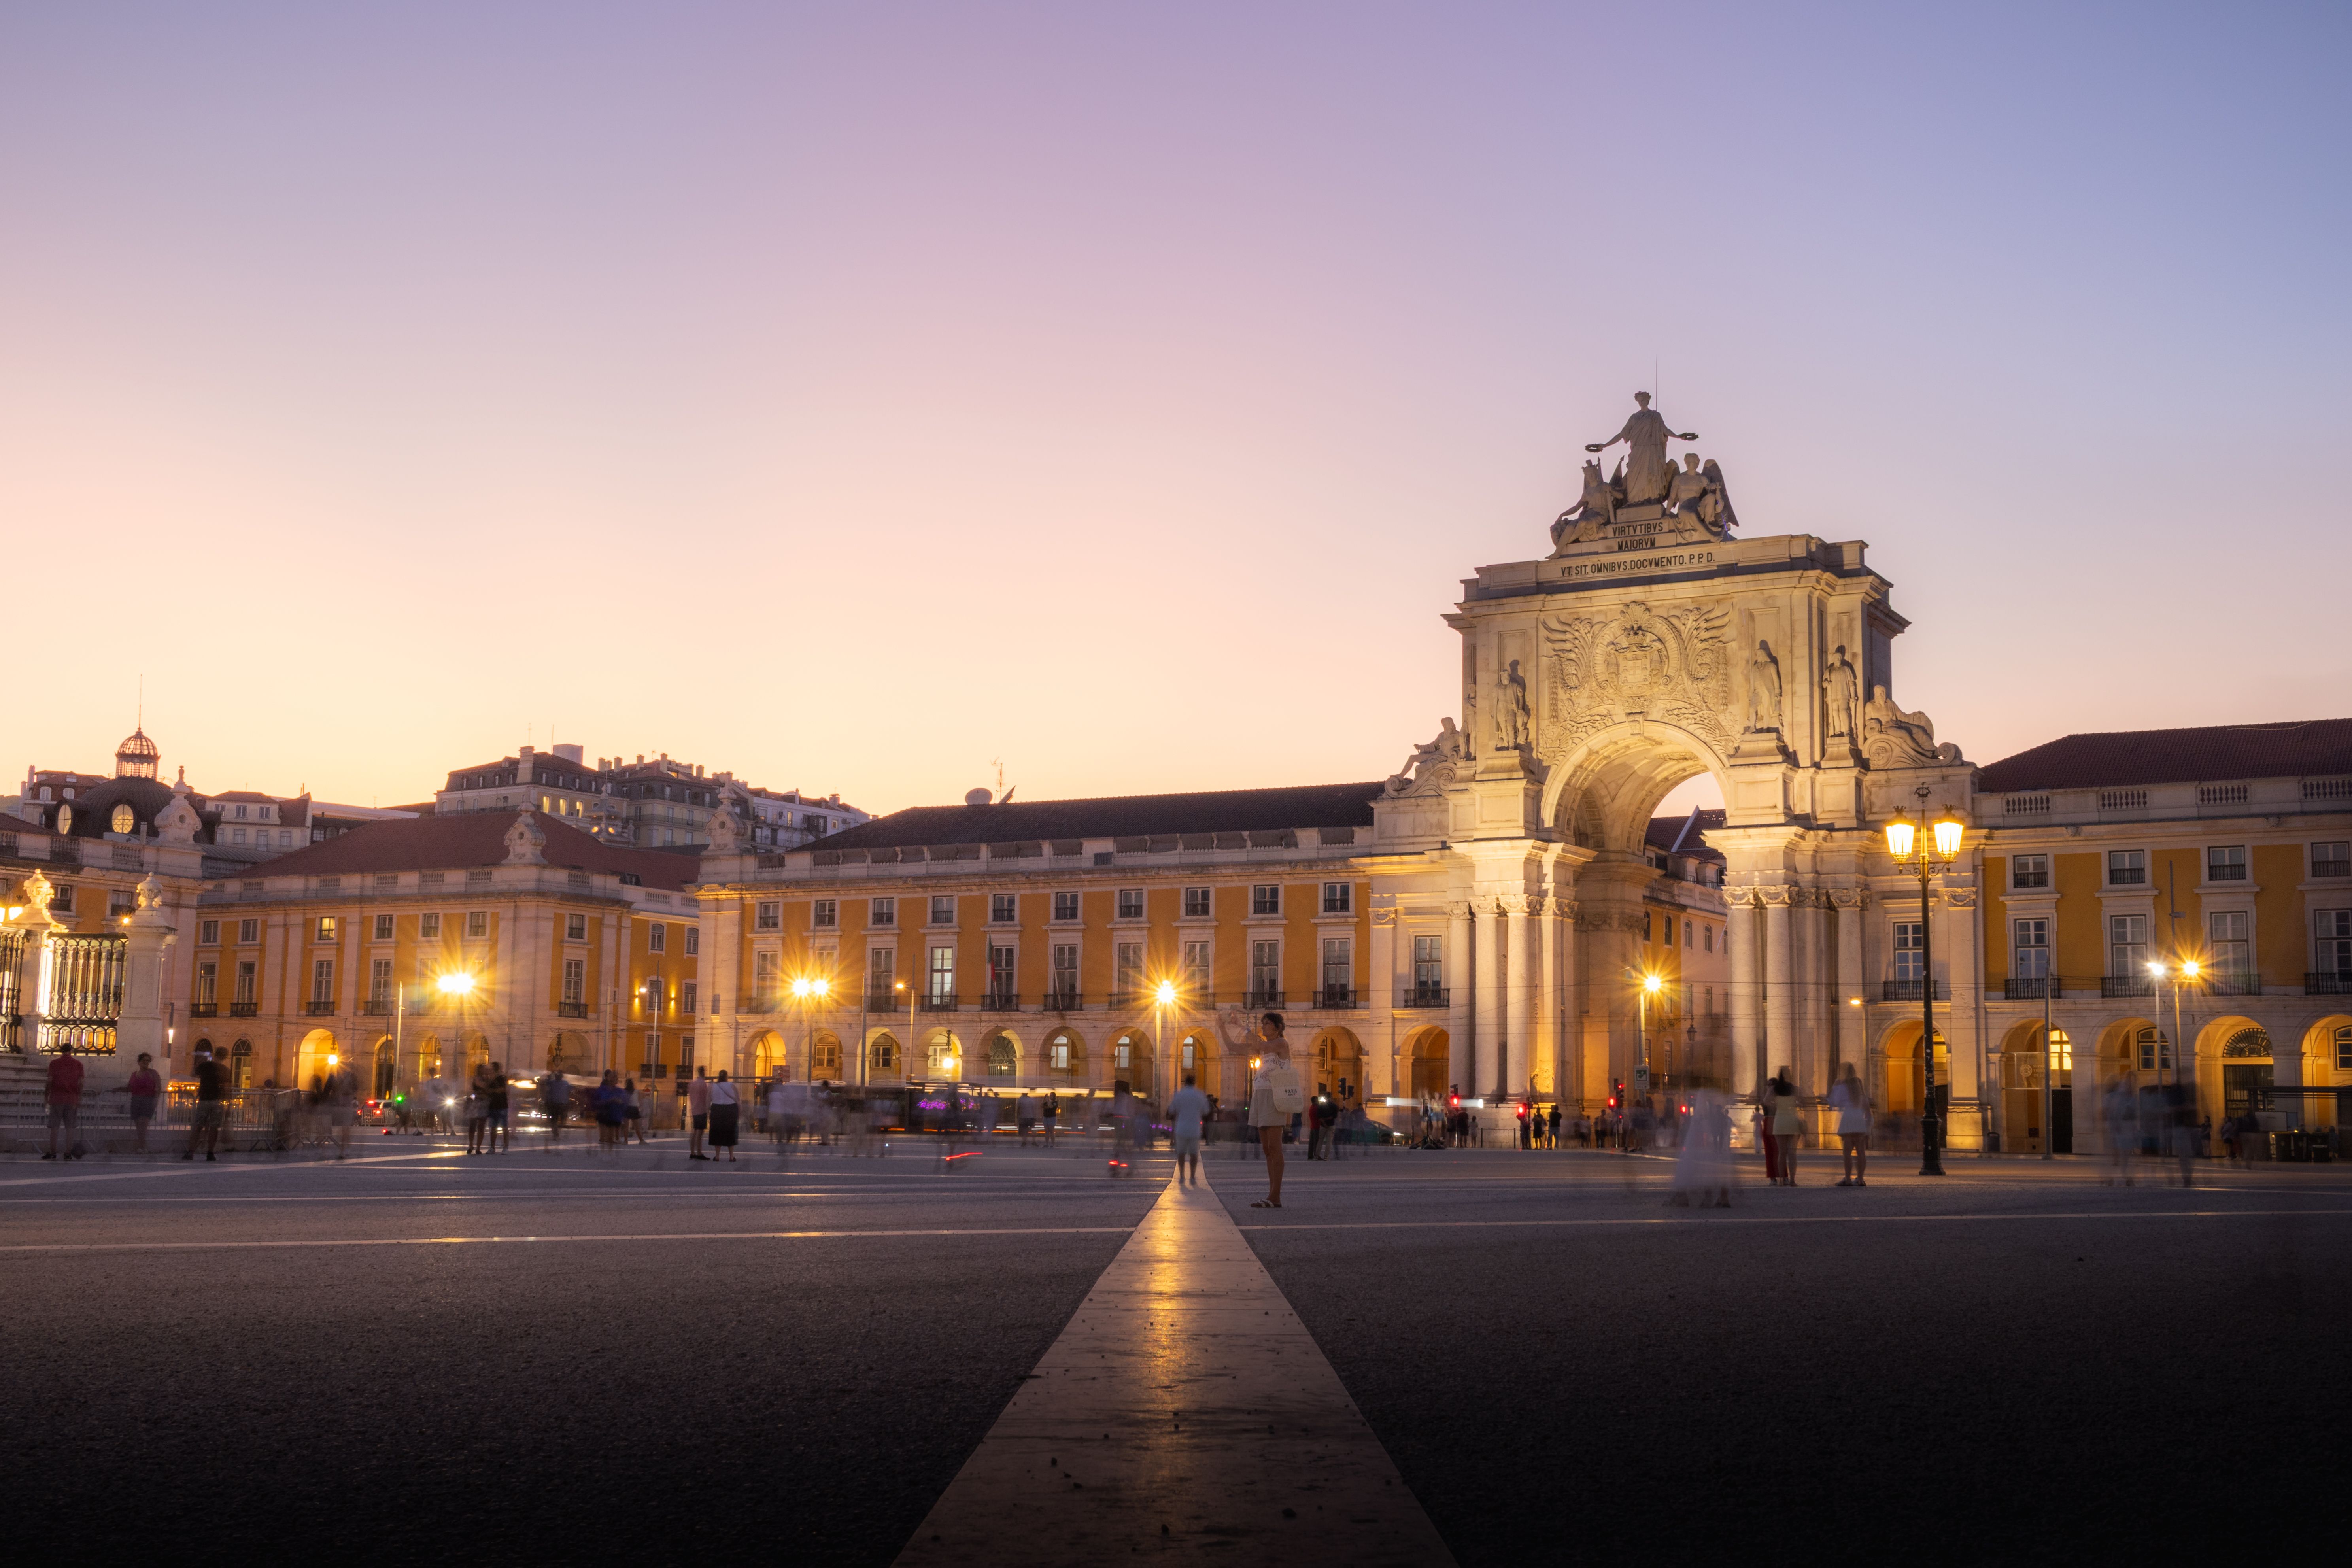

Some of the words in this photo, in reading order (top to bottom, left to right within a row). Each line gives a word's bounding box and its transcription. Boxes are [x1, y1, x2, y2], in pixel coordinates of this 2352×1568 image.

[1612, 522, 1663, 537] VIRTVTIBVS
[1617, 537, 1656, 551] MAIORVM
[1561, 566, 1573, 576] VT.
[1575, 565, 1589, 576] SIT.
